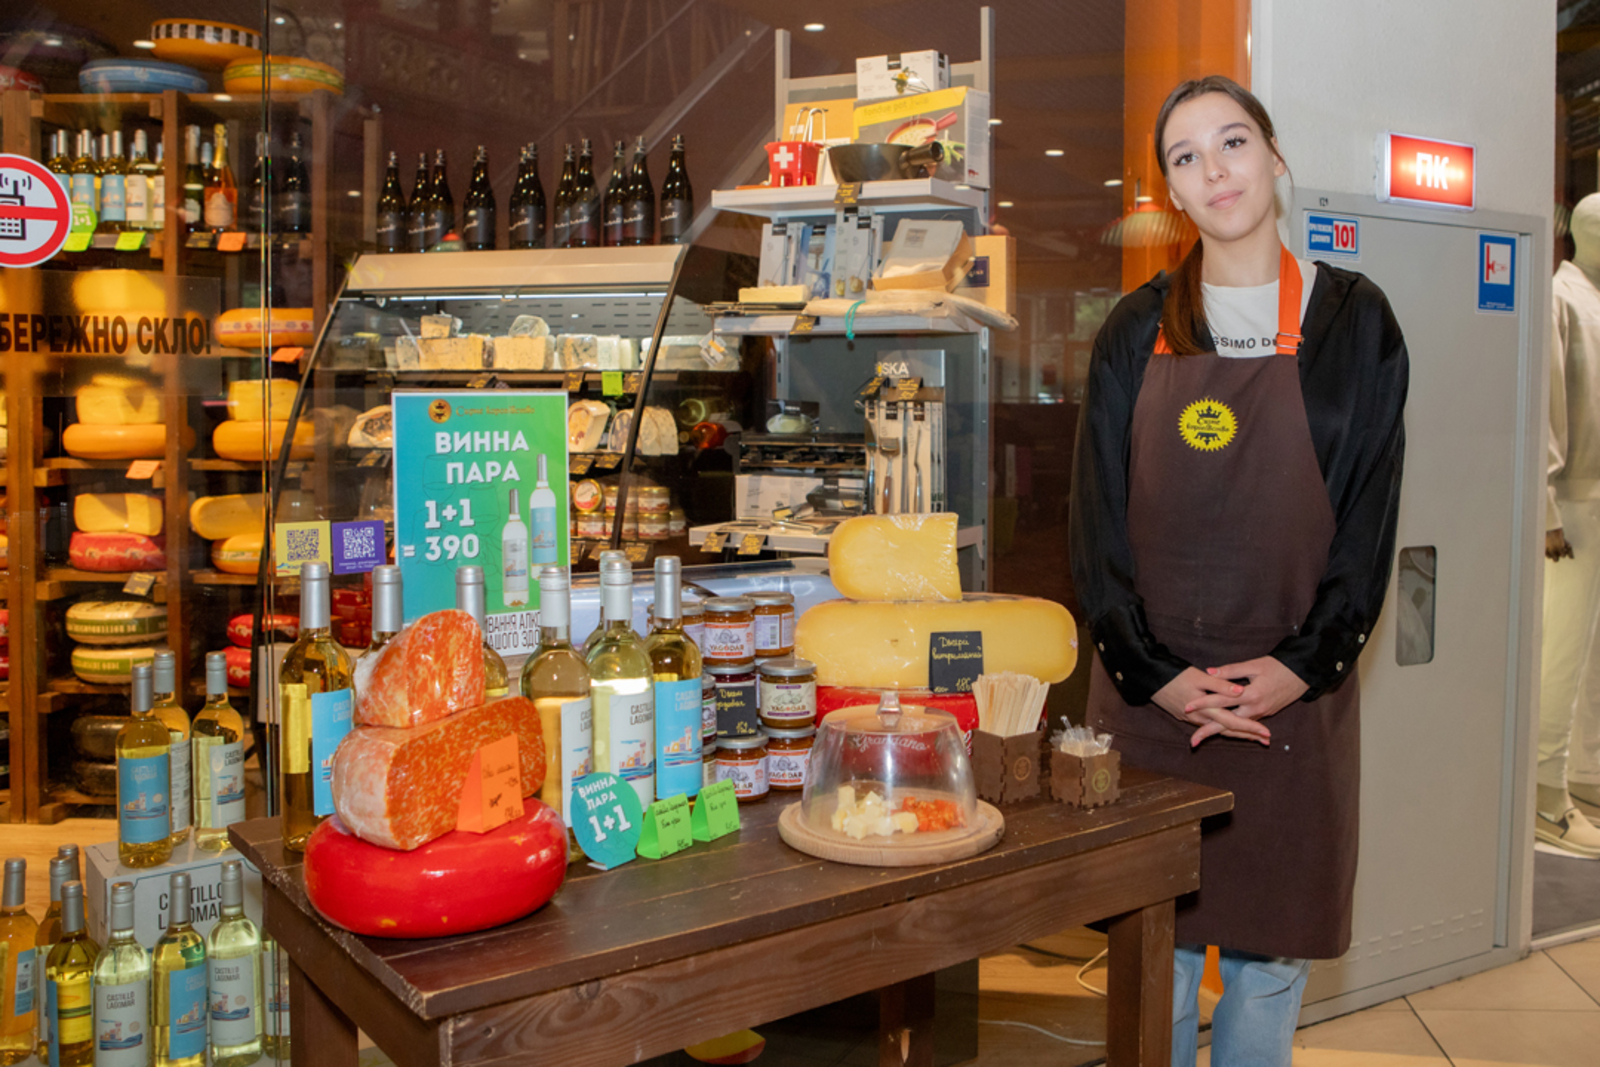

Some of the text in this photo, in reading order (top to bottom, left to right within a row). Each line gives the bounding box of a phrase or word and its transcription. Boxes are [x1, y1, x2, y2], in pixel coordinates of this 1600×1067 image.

[1416, 152, 1449, 190] ПК
[1334, 224, 1355, 249] 101
[136, 316, 211, 355] СКЛО!
[435, 430, 530, 454] ВИННА
[446, 460, 521, 484] ПАРА
[425, 499, 475, 529] 1+1
[425, 534, 480, 561] 390
[485, 614, 517, 634] ВАННЯ
[485, 631, 519, 650] АШОГО
[578, 775, 617, 799] ВИННА
[586, 790, 617, 811] ПАРА
[589, 804, 632, 843] 1+1
